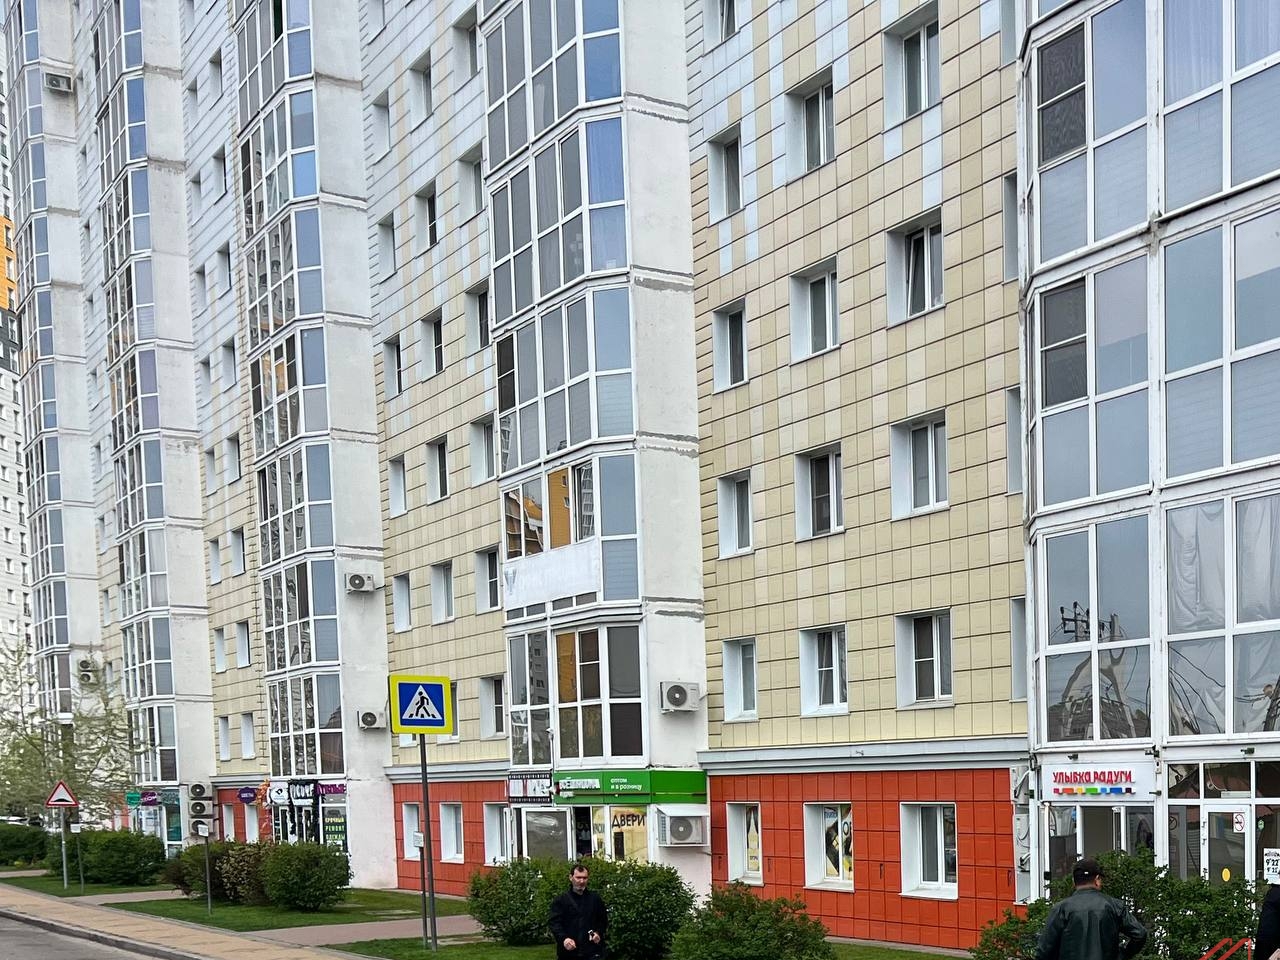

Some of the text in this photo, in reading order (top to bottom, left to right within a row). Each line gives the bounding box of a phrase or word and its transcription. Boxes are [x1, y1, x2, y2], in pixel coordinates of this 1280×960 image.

[1053, 770, 1132, 785] УЛЫБКА РАДУГИ
[612, 814, 645, 828] ДВЕРИ
